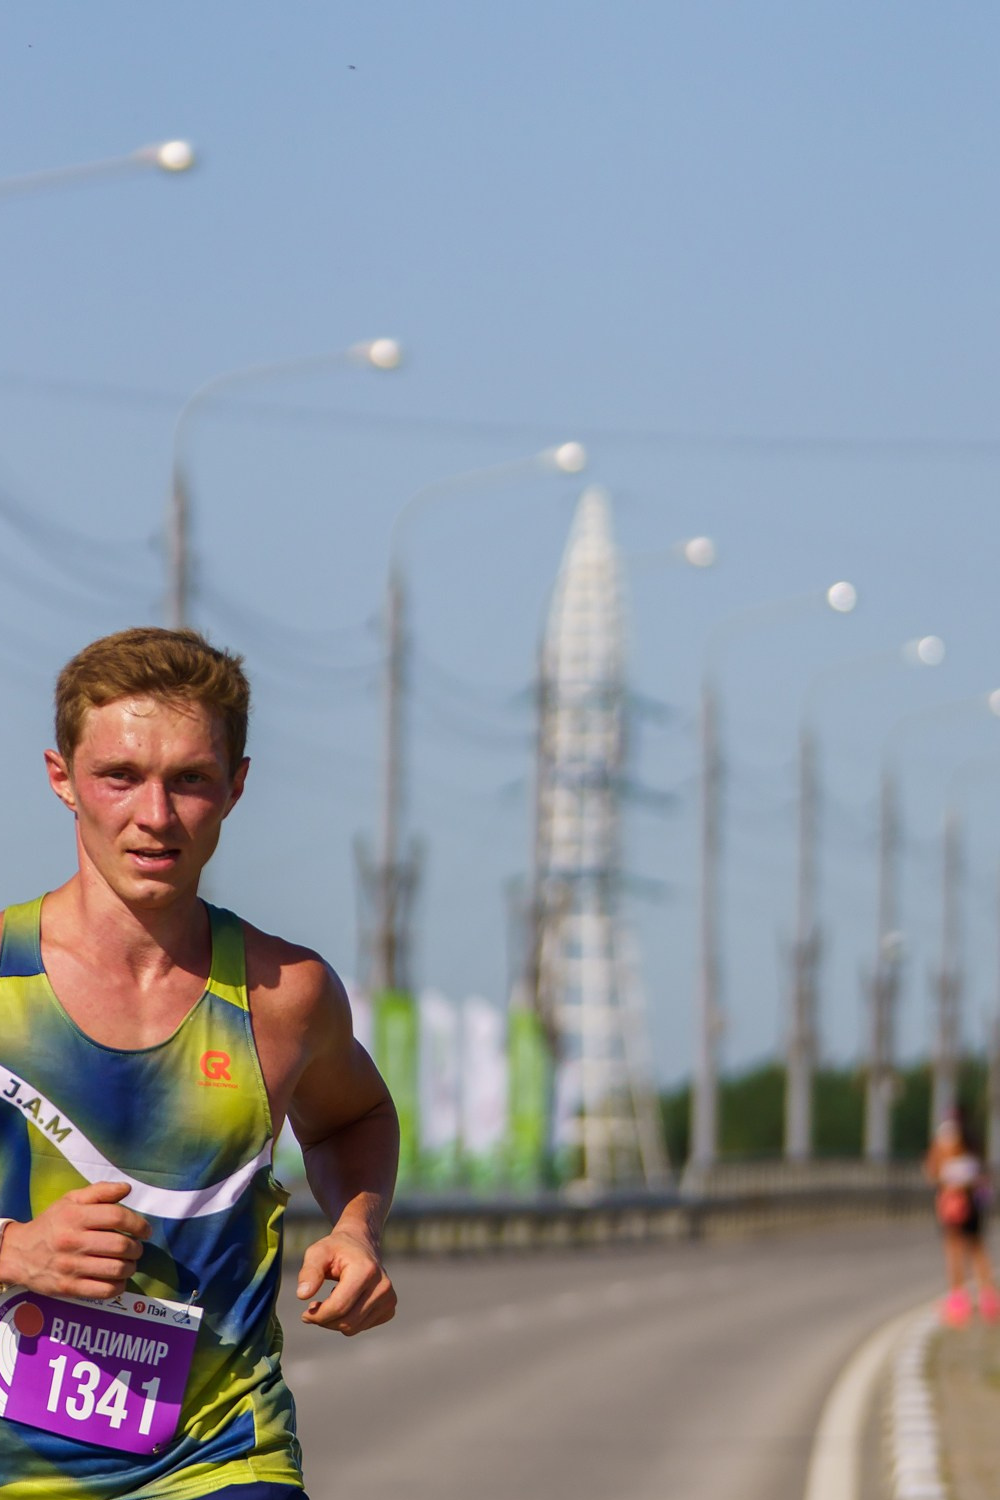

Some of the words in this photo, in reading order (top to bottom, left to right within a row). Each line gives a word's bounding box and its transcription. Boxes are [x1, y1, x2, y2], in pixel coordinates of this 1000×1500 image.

[147, 1304, 167, 1318] Пэй
[50, 1317, 168, 1365] ВЛАДИМИР
[46, 1354, 161, 1436] 1341
